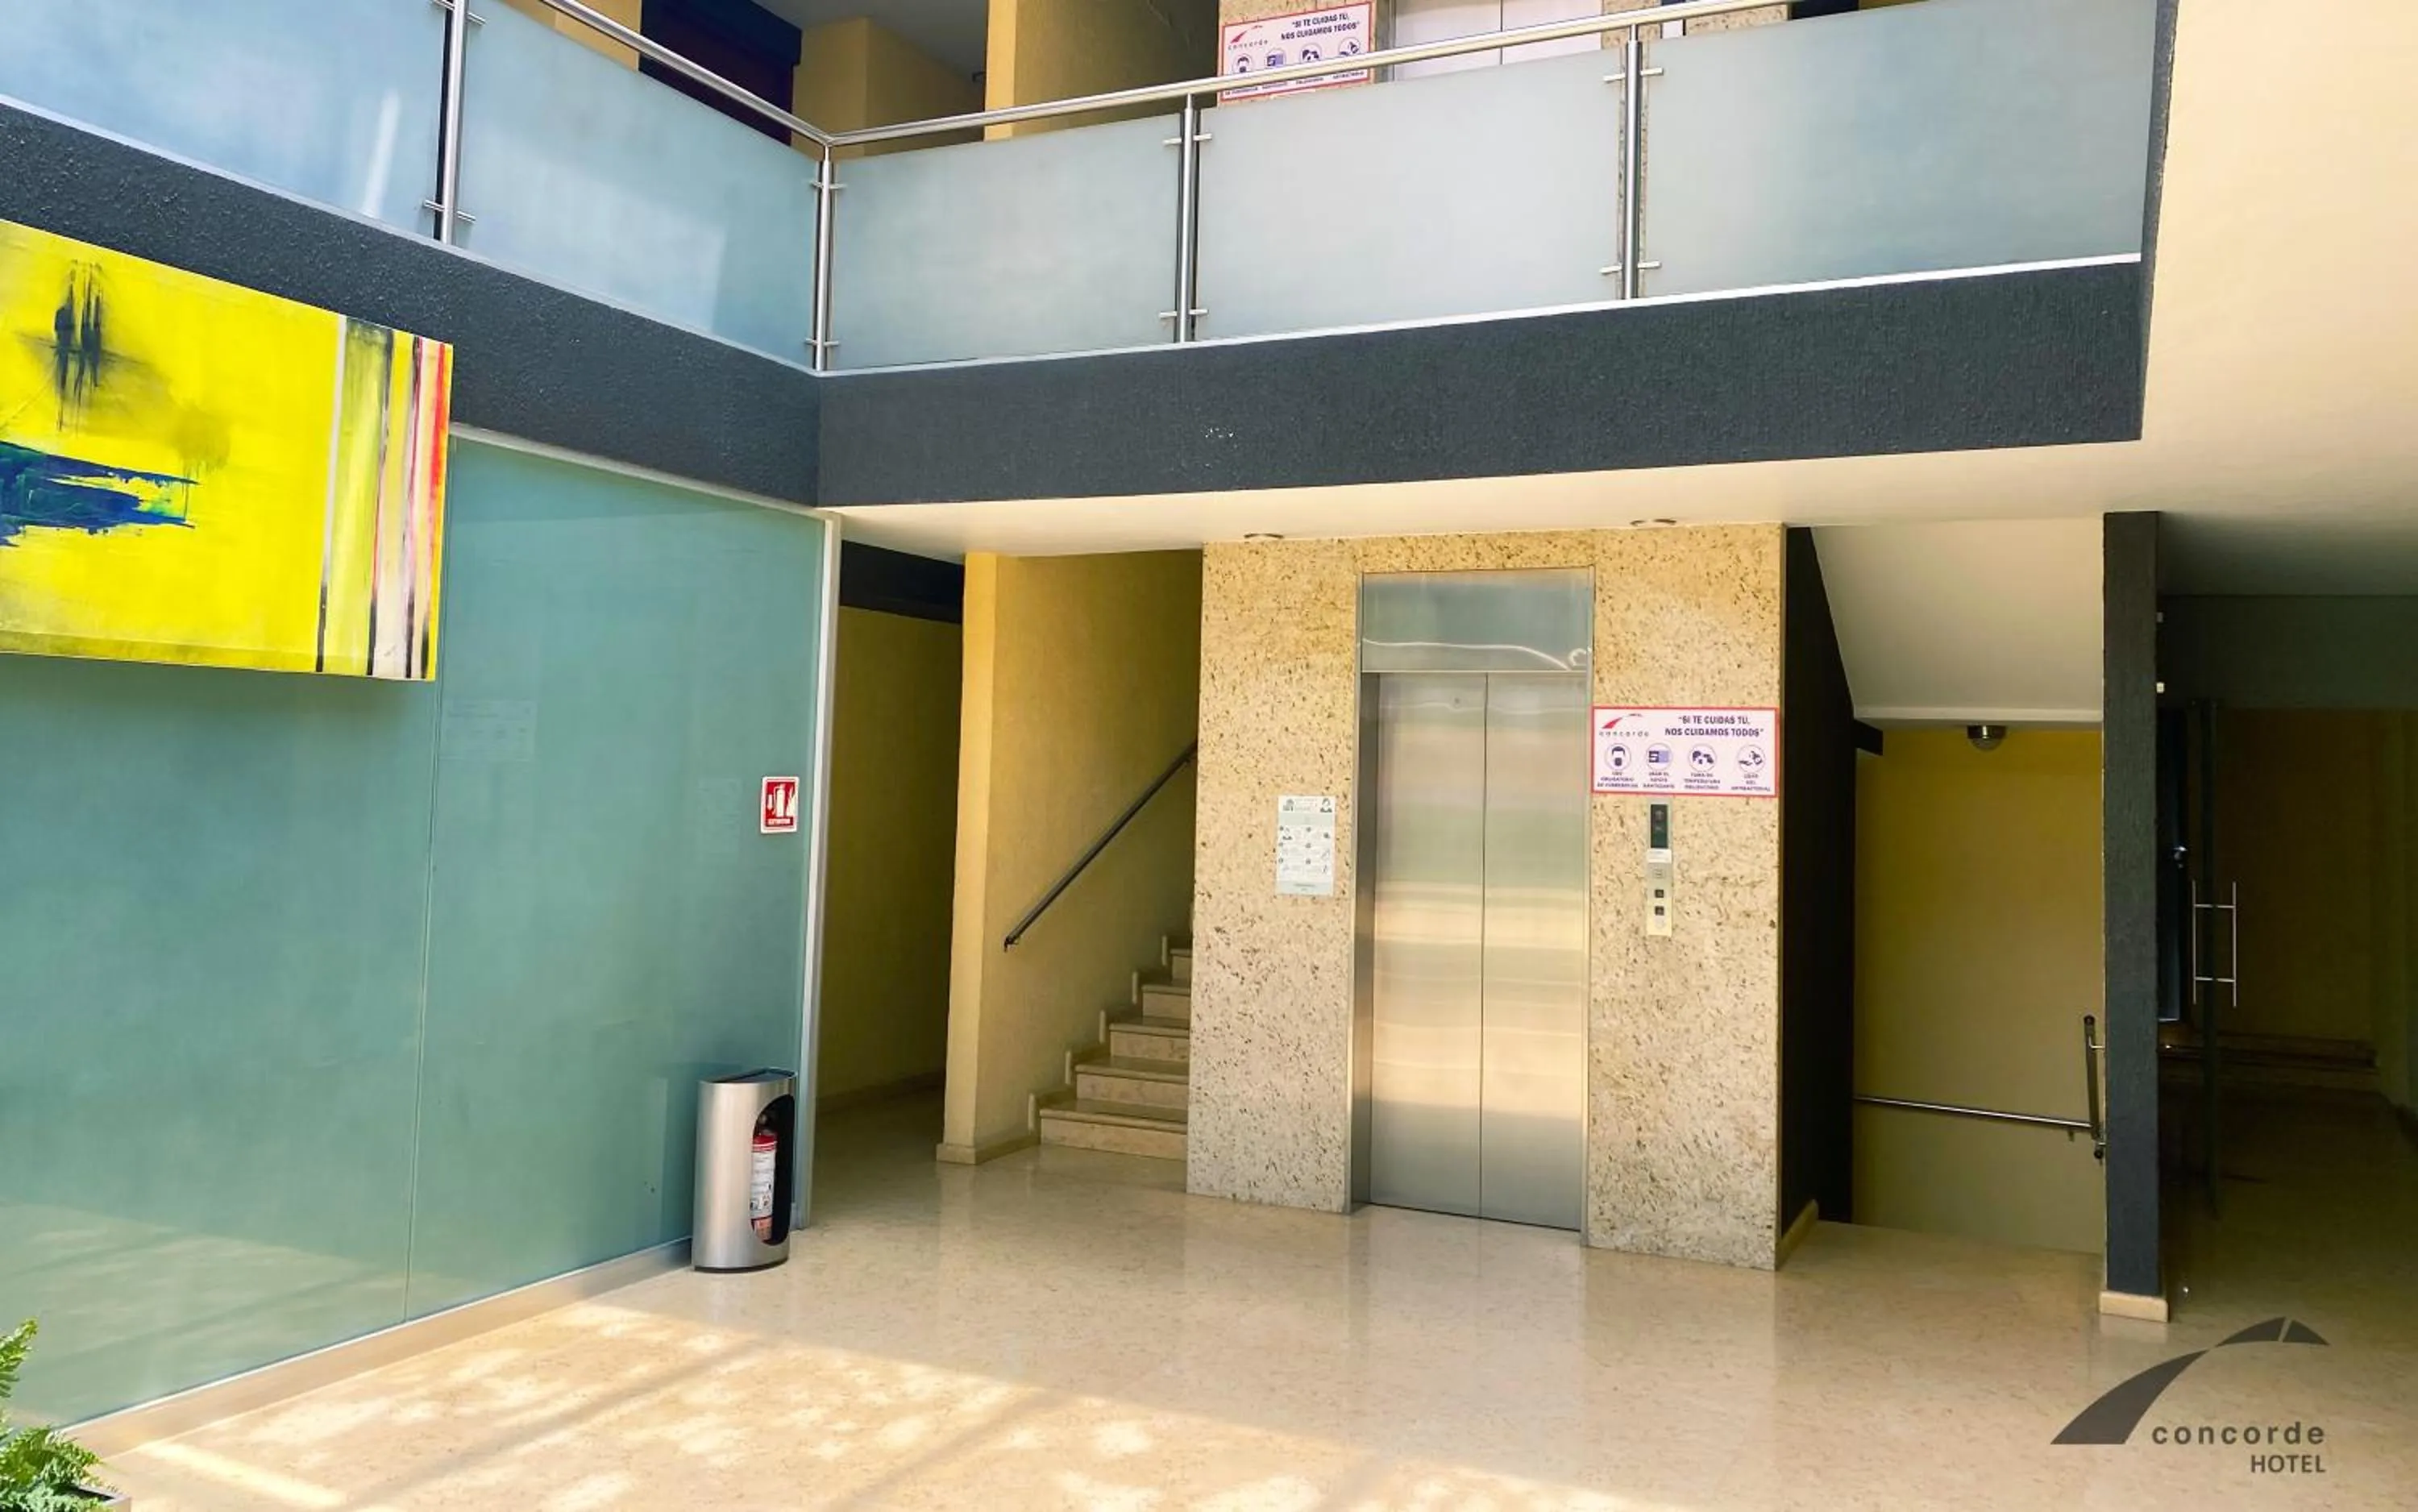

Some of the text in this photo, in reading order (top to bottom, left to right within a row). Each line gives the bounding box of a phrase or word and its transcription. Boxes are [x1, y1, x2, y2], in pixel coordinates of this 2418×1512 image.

[1693, 715, 1702, 725] TE
[1704, 715, 1735, 725] CUIDAS
[1664, 728, 1683, 736] NOS
[1684, 728, 1729, 737] CUIDAMOS
